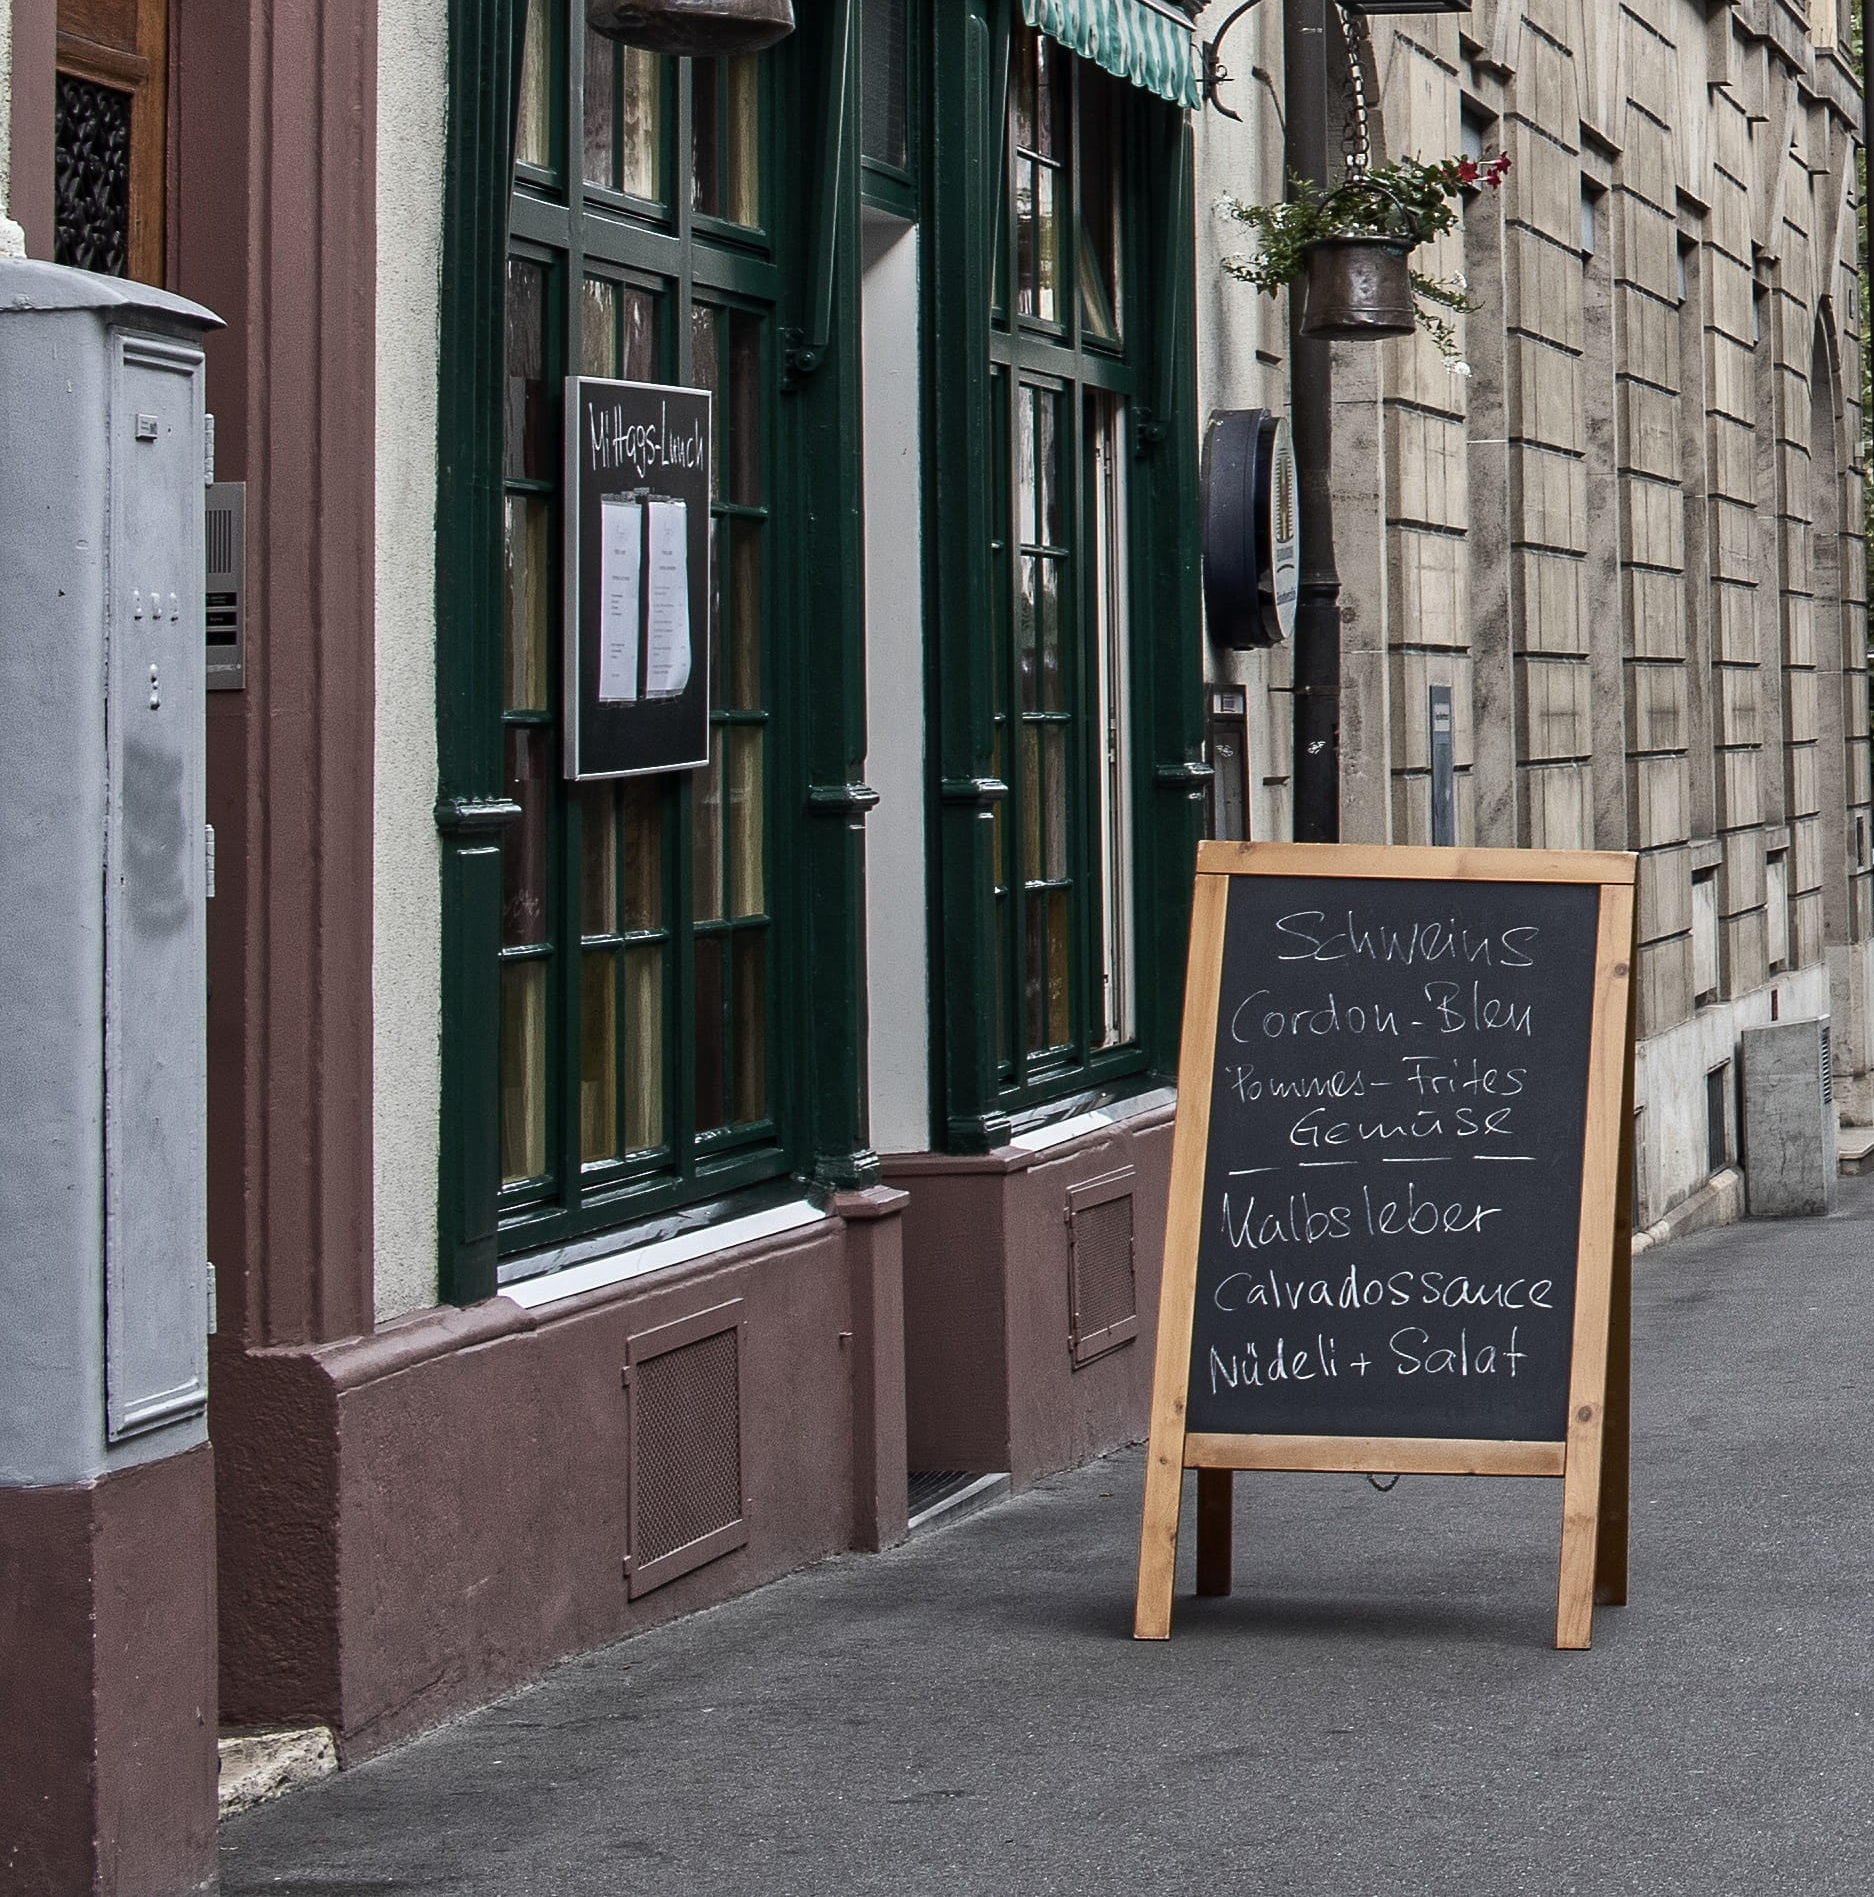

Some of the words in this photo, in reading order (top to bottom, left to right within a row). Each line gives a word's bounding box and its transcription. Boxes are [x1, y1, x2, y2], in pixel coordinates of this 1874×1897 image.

[588, 400, 704, 478] Mittags-Lunch
[1277, 909, 1540, 968] Schweins
[1289, 1107, 1514, 1148] Gemüse
[1221, 1183, 1502, 1250] Kalbsleber
[1215, 1263, 1553, 1311] Calvadossauce
[1211, 1333, 1340, 1393] Nüdeli
[1350, 1352, 1372, 1378] +
[1389, 1326, 1528, 1377] Salat
